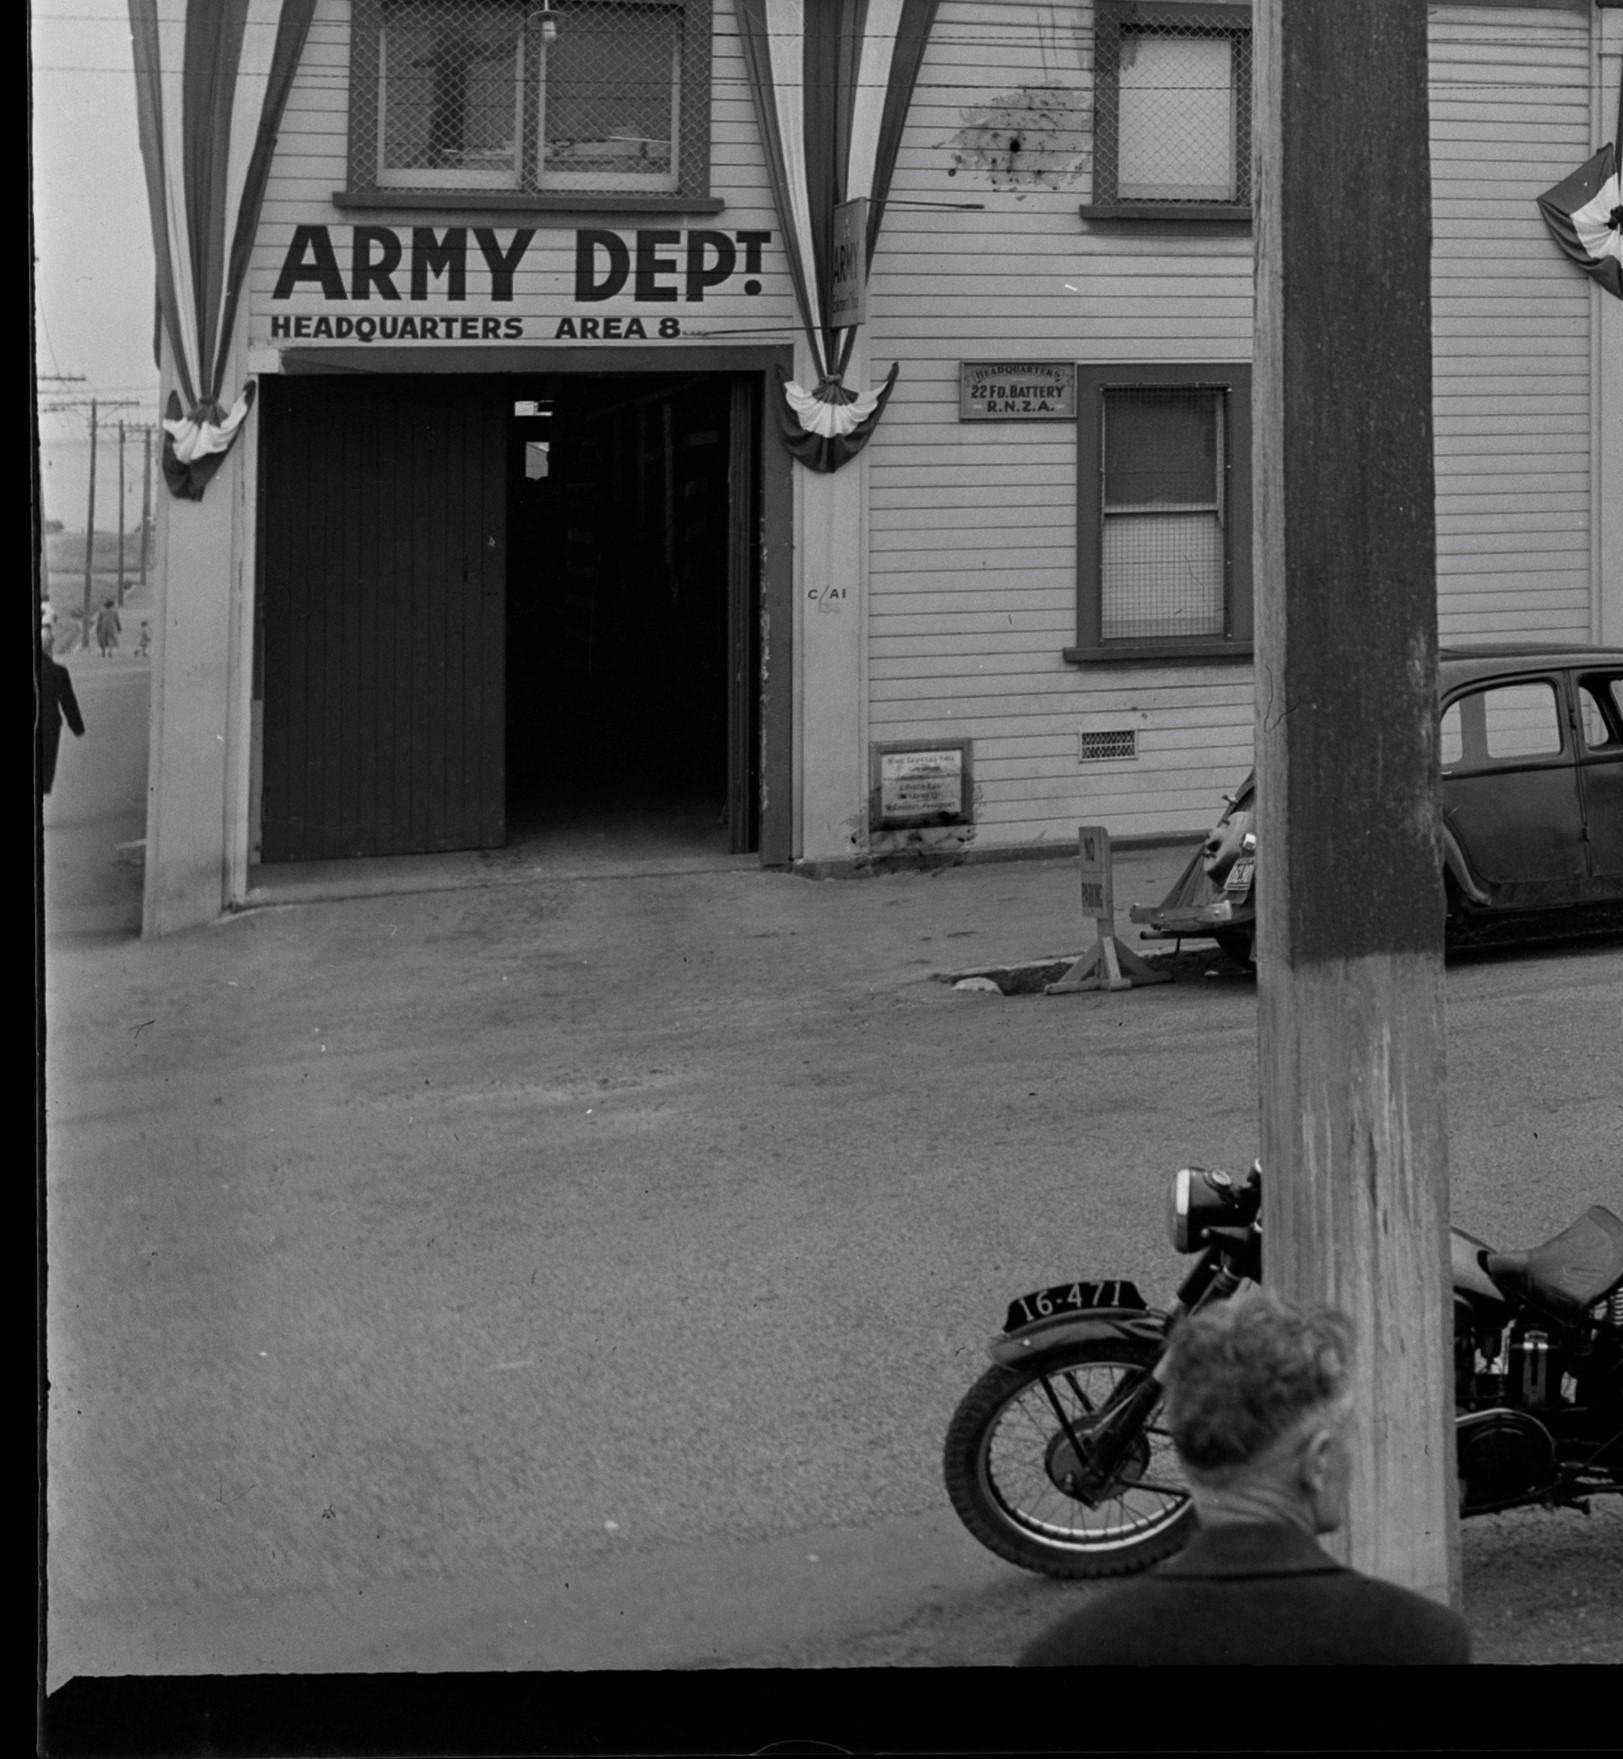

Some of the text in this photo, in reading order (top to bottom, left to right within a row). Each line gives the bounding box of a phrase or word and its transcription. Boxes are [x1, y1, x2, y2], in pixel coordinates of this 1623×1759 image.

[271, 224, 537, 302] ARMY
[270, 315, 682, 343] HEADQUARTERS AREA 8
